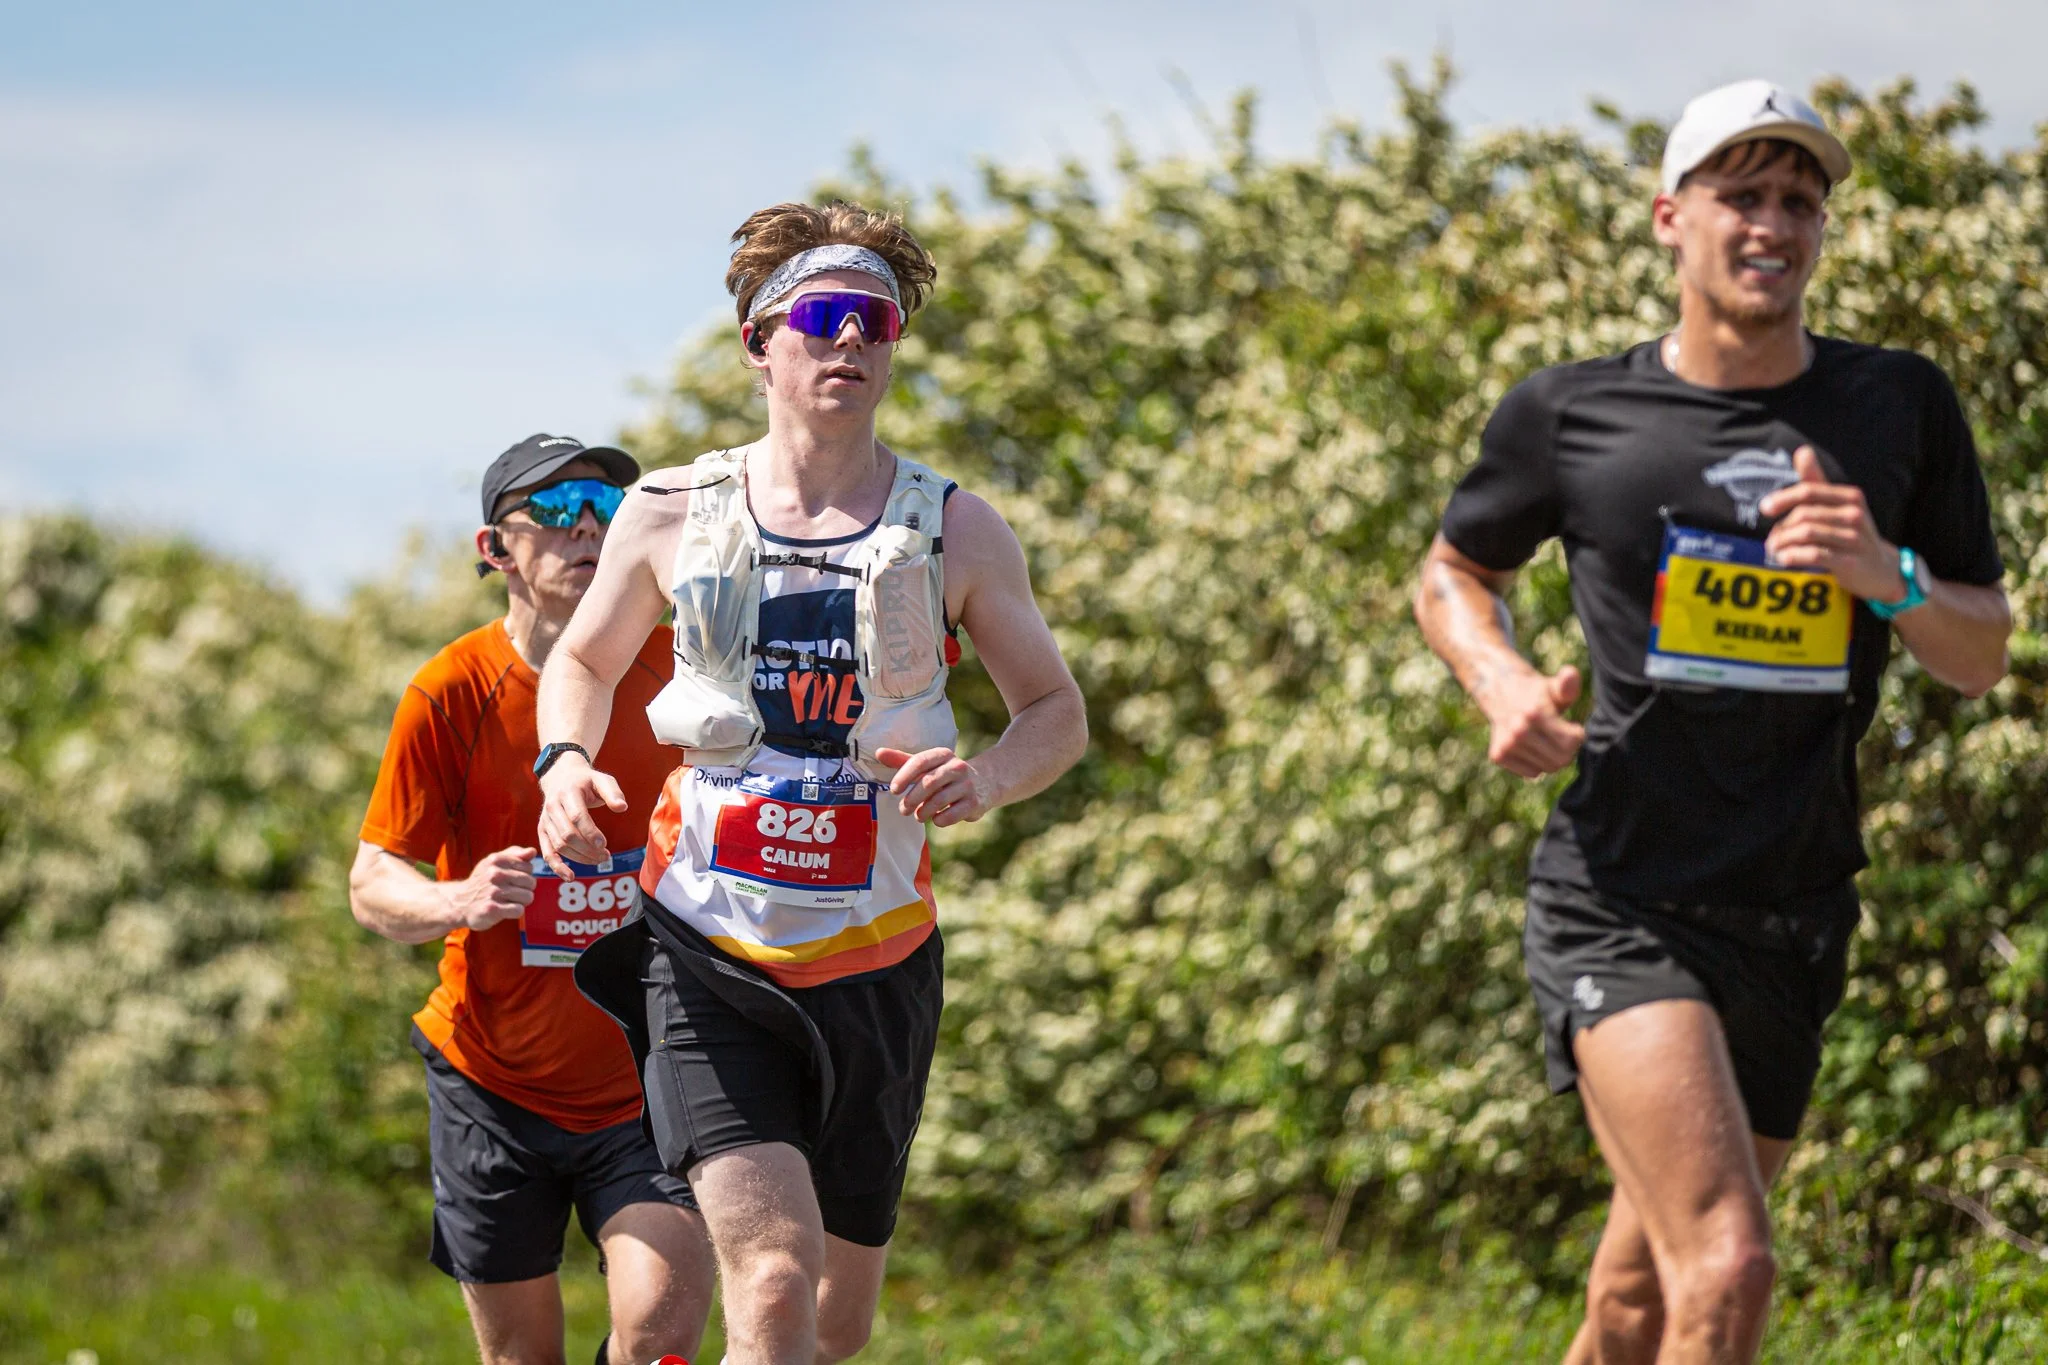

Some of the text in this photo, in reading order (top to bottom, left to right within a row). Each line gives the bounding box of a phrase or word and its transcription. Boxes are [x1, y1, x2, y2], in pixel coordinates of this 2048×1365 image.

[1694, 567, 1831, 616] 4098
[1714, 618, 1803, 645] KIERAN
[753, 672, 786, 691] OR
[756, 802, 837, 844] 826
[760, 846, 831, 869] CALUM
[558, 876, 637, 913] 869
[736, 881, 768, 893] MACMILLAN
